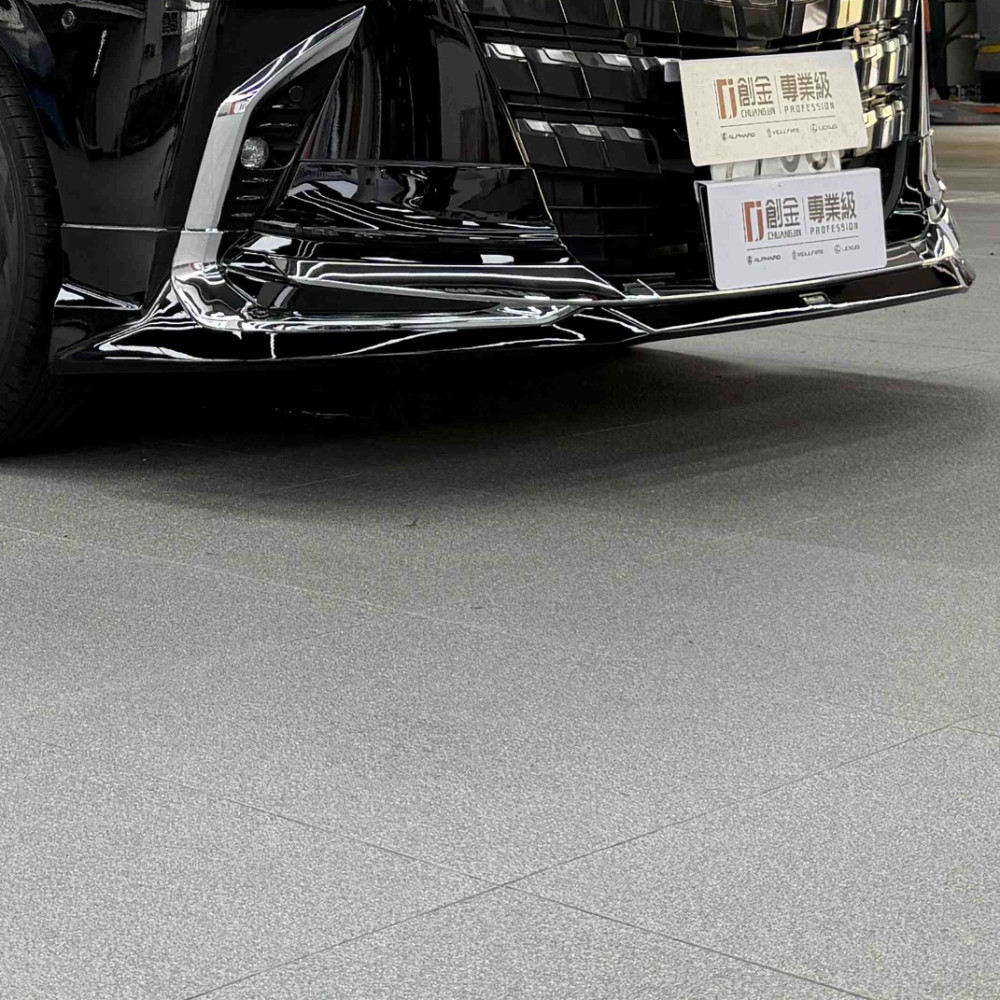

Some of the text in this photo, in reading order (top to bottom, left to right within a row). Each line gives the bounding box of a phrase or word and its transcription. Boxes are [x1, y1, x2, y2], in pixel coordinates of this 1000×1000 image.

[737, 71, 833, 107] 創金 專業級
[784, 102, 835, 114] PROFESSION
[766, 191, 858, 229] 創金 專業級
[810, 222, 859, 235] PROFESSION
